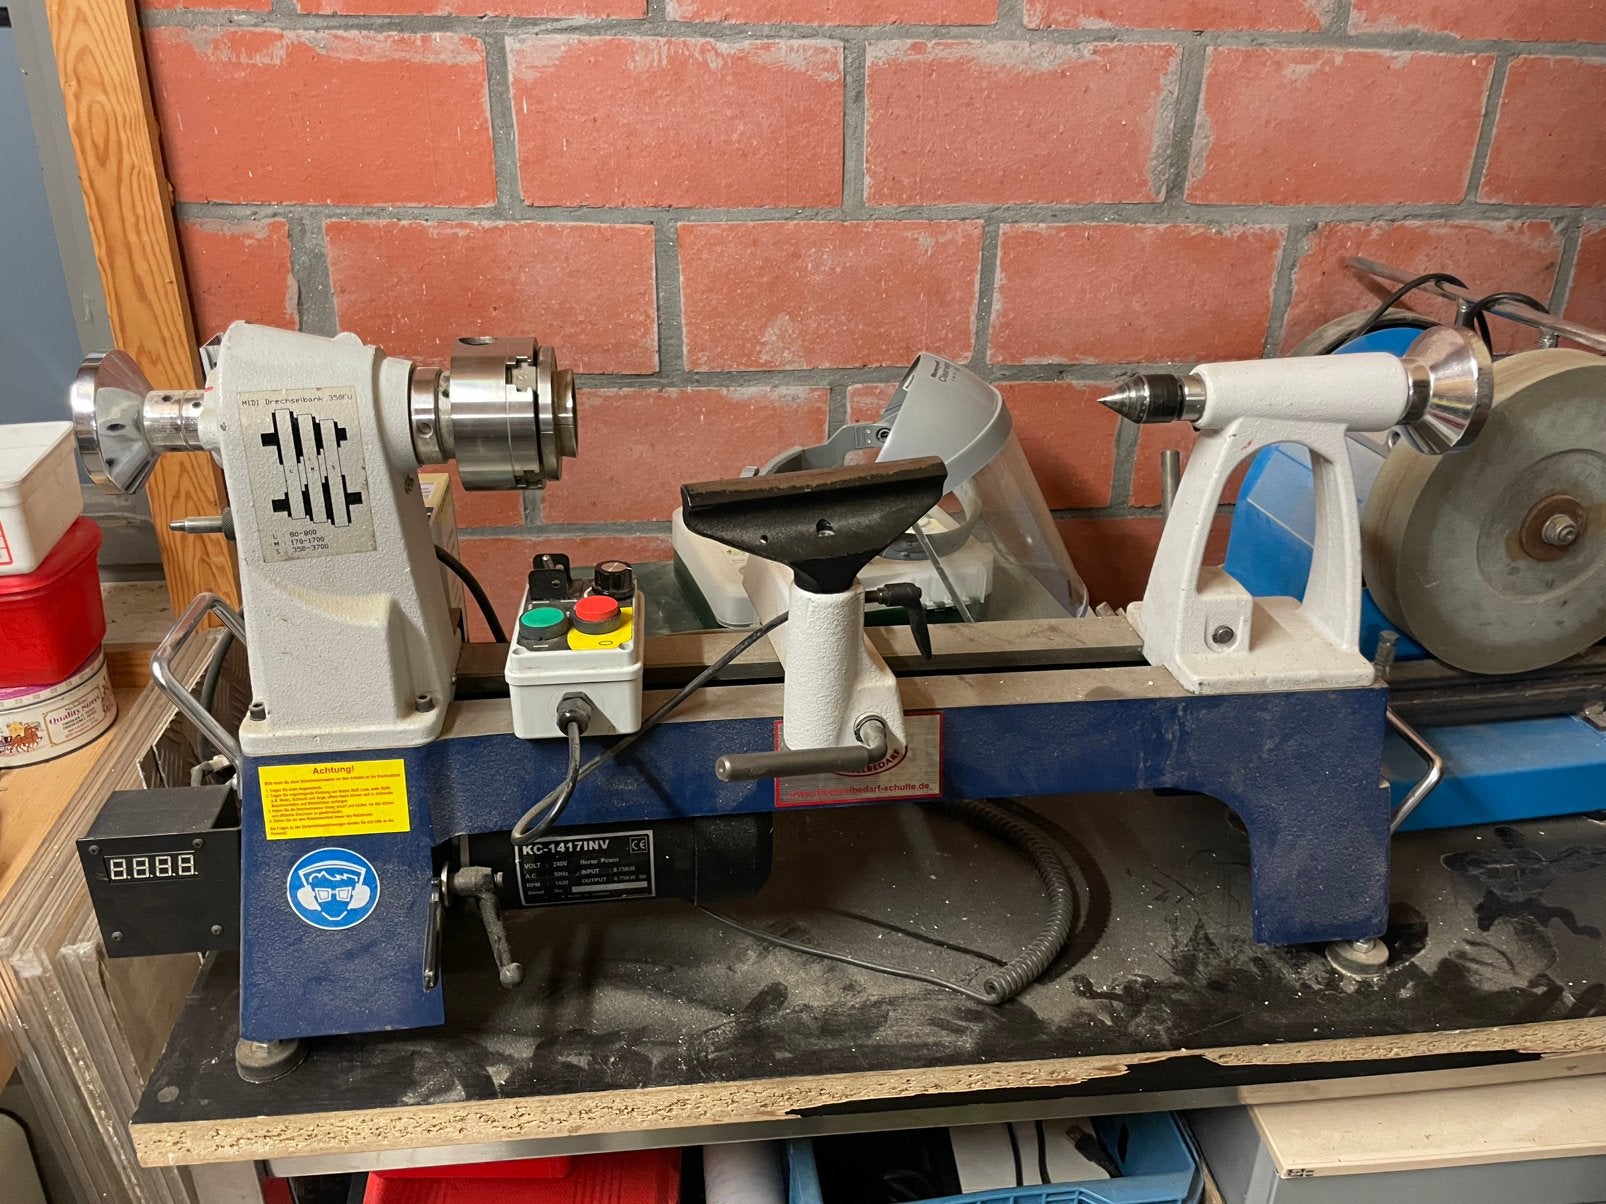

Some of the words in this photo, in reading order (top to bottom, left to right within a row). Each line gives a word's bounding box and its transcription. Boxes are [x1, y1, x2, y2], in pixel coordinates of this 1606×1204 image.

[265, 395, 323, 406] Drechselbank
[289, 529, 317, 538] 80-800
[290, 536, 325, 546] 170-1700
[292, 543, 329, 553] 350-3700
[49, 709, 80, 725] Quality
[312, 765, 354, 775] Achtung!
[522, 839, 610, 856] KC-1417INV
